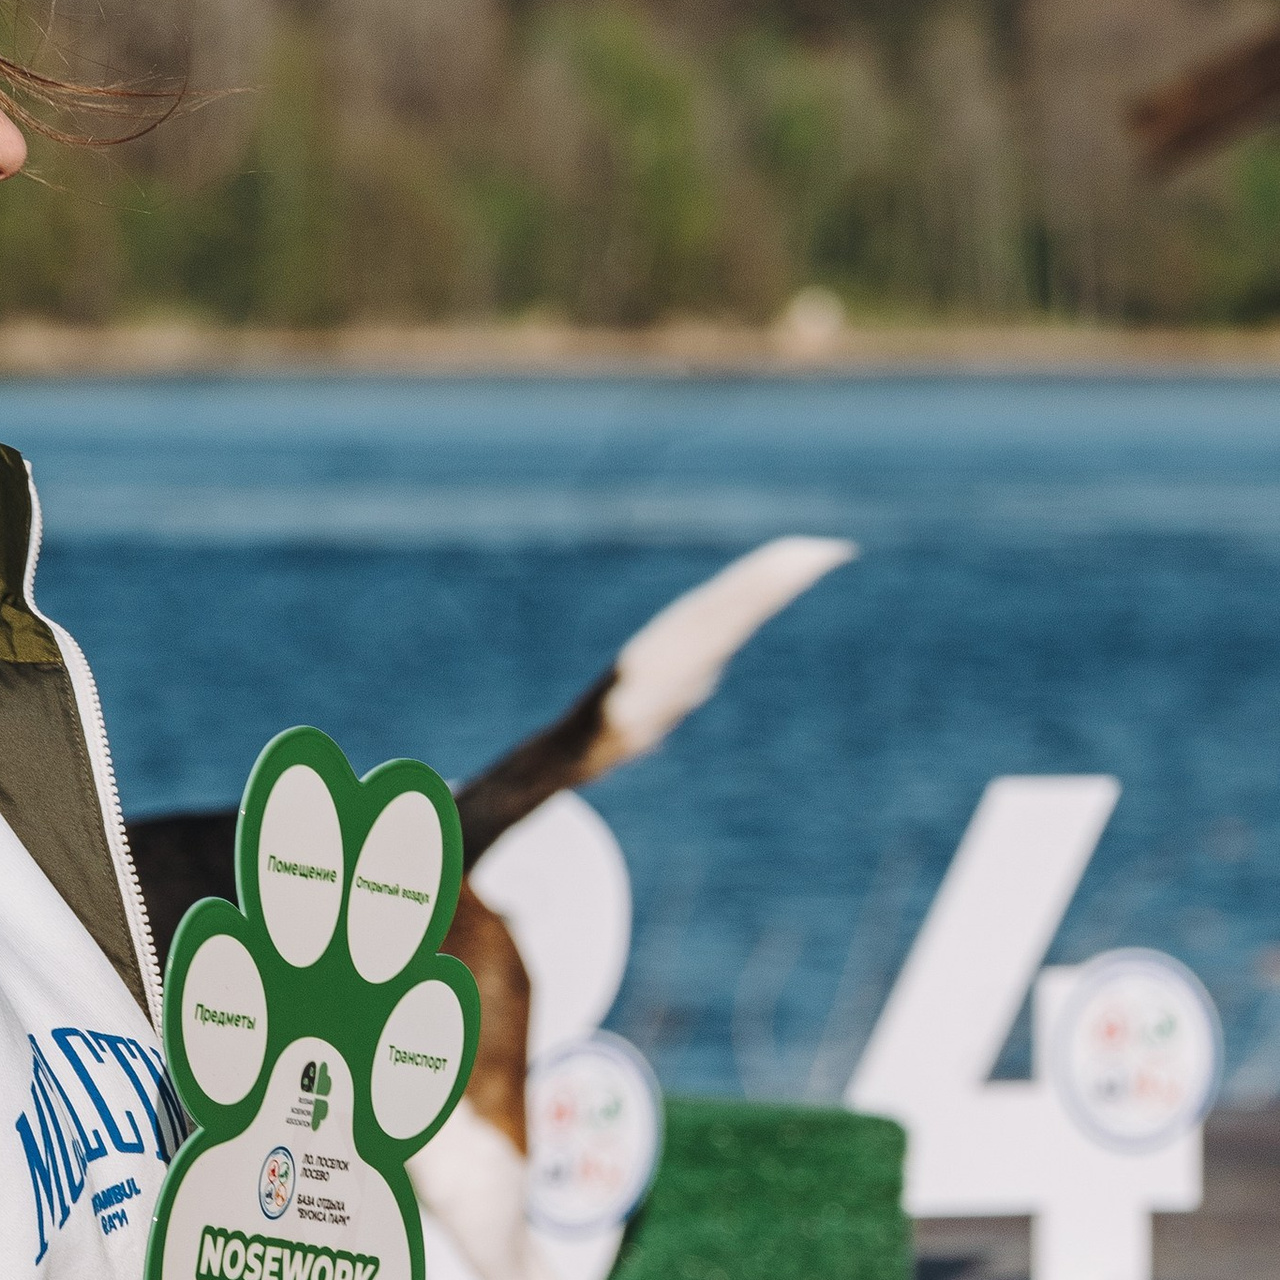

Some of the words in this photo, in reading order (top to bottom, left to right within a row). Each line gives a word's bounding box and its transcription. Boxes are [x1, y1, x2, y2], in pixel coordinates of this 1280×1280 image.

[268, 854, 337, 883] Помещение
[356, 875, 400, 896] Открытый
[402, 888, 429, 905] воздух
[195, 1003, 256, 1031] Предметы
[389, 1045, 448, 1072] Транспорт
